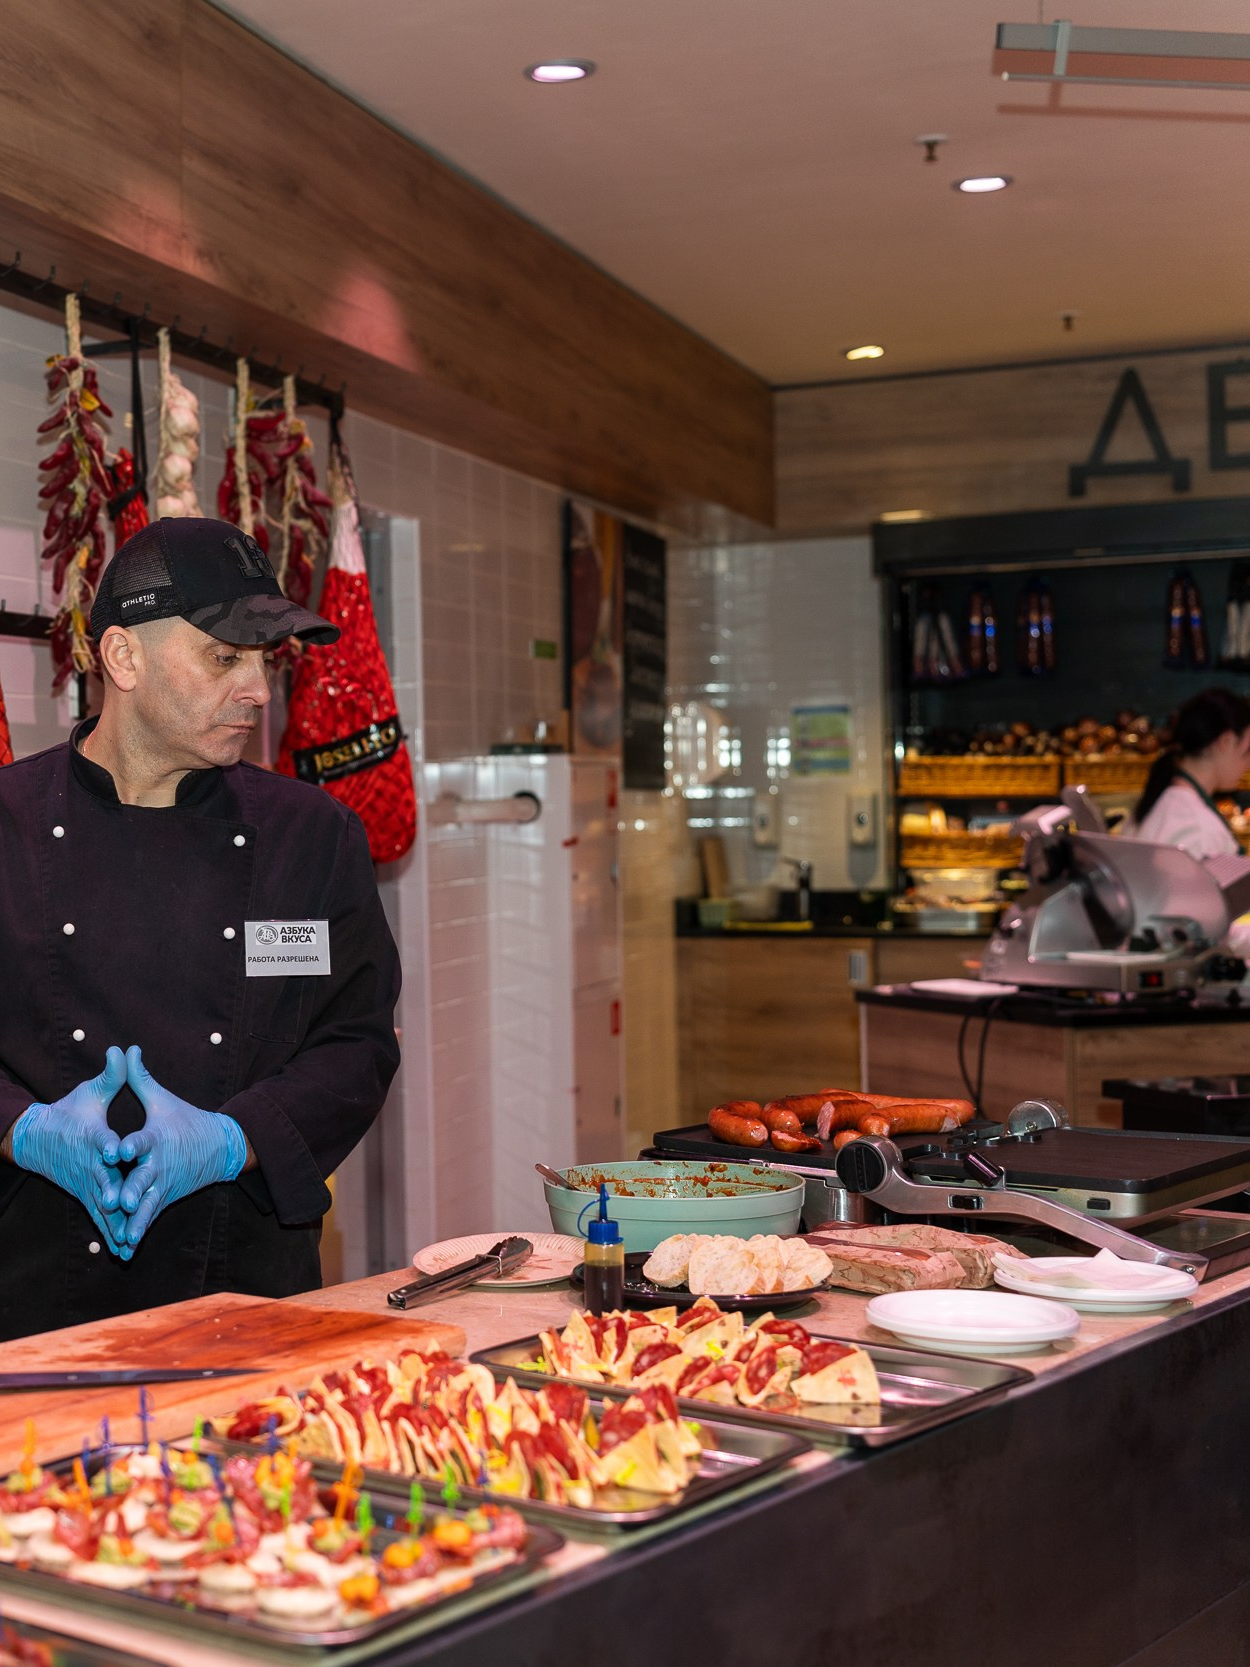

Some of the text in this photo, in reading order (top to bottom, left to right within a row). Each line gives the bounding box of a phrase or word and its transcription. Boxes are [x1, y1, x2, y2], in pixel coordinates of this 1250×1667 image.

[280, 926, 316, 935] АЗБУКА
[281, 935, 312, 943] ВКУСА
[277, 955, 320, 963] РАЗРЕШЕНА
